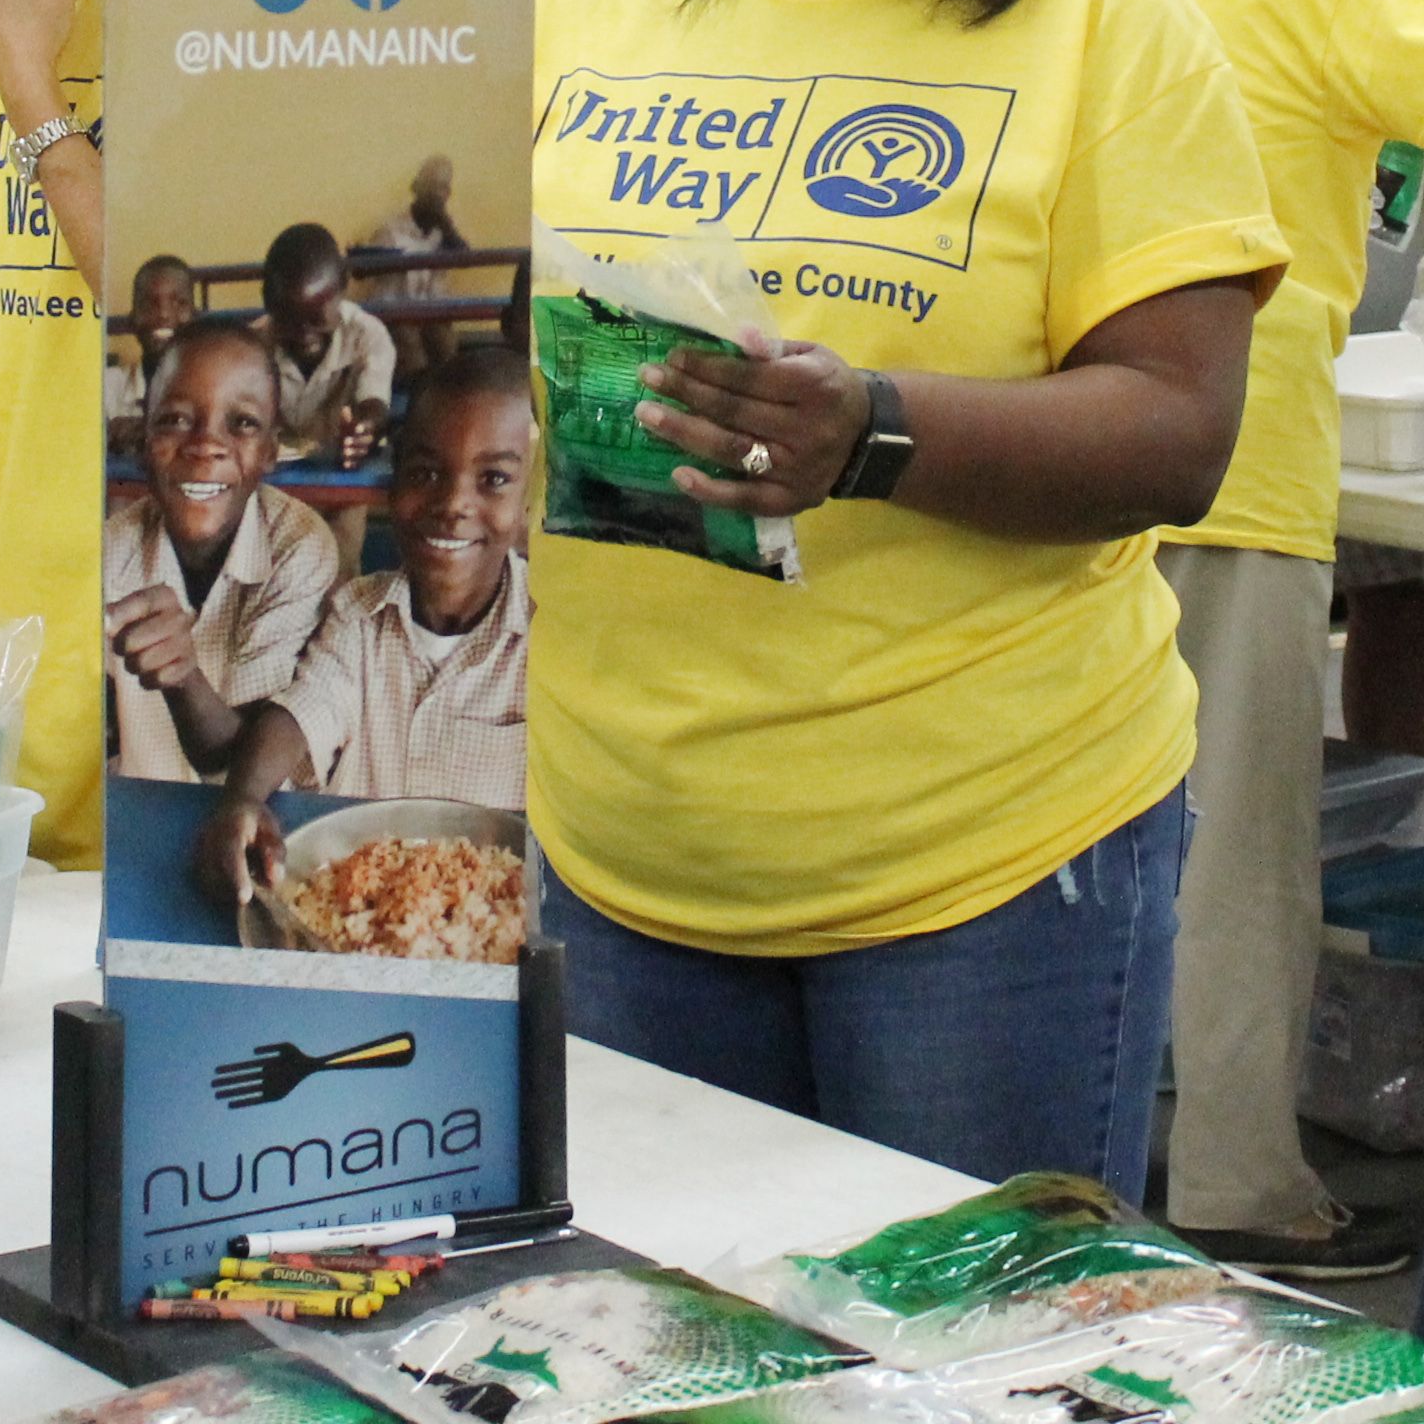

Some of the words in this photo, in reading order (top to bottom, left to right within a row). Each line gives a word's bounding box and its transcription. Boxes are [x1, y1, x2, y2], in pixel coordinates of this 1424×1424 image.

[175, 25, 478, 75] @NUMANAINC
[555, 88, 788, 151] United
[608, 149, 762, 224] Way
[794, 262, 939, 324] County
[142, 1107, 483, 1216] numana
[371, 1186, 484, 1223] HUNGRY
